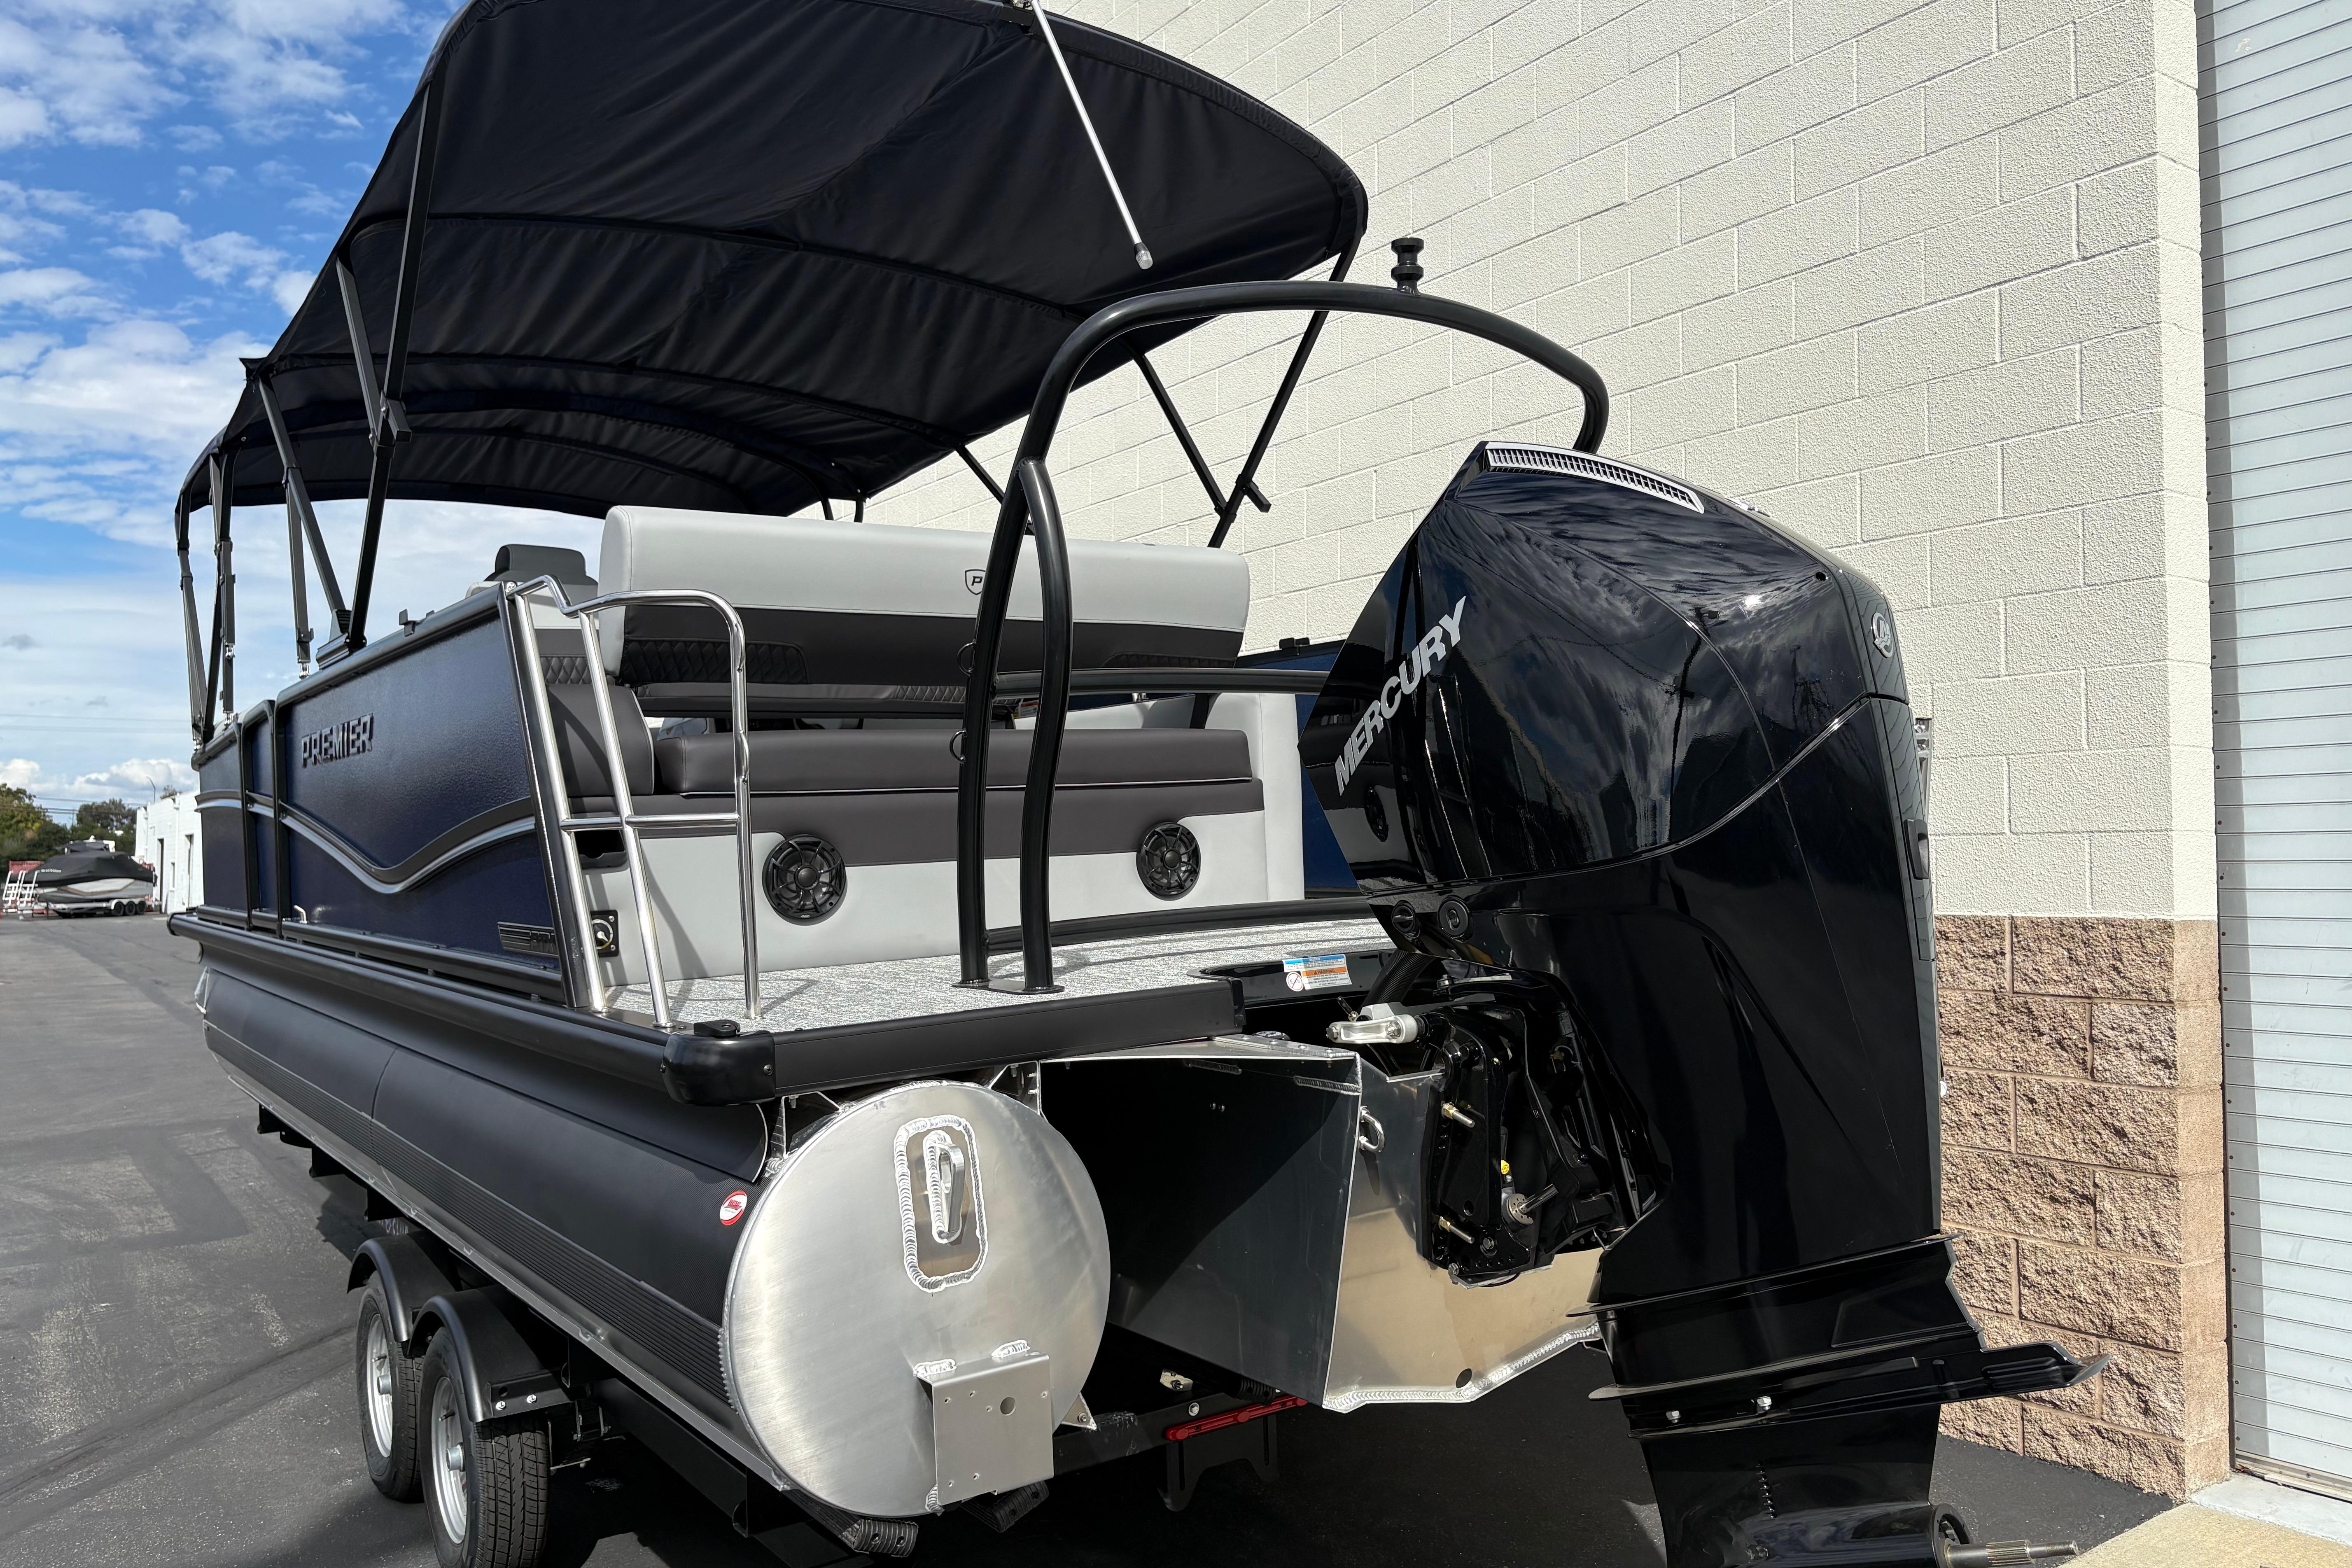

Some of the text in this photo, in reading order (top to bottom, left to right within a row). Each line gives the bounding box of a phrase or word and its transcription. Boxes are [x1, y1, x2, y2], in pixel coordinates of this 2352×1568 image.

[971, 576, 983, 586] P
[1335, 595, 1466, 796] MERCURY
[301, 713, 373, 768] PREMIER
